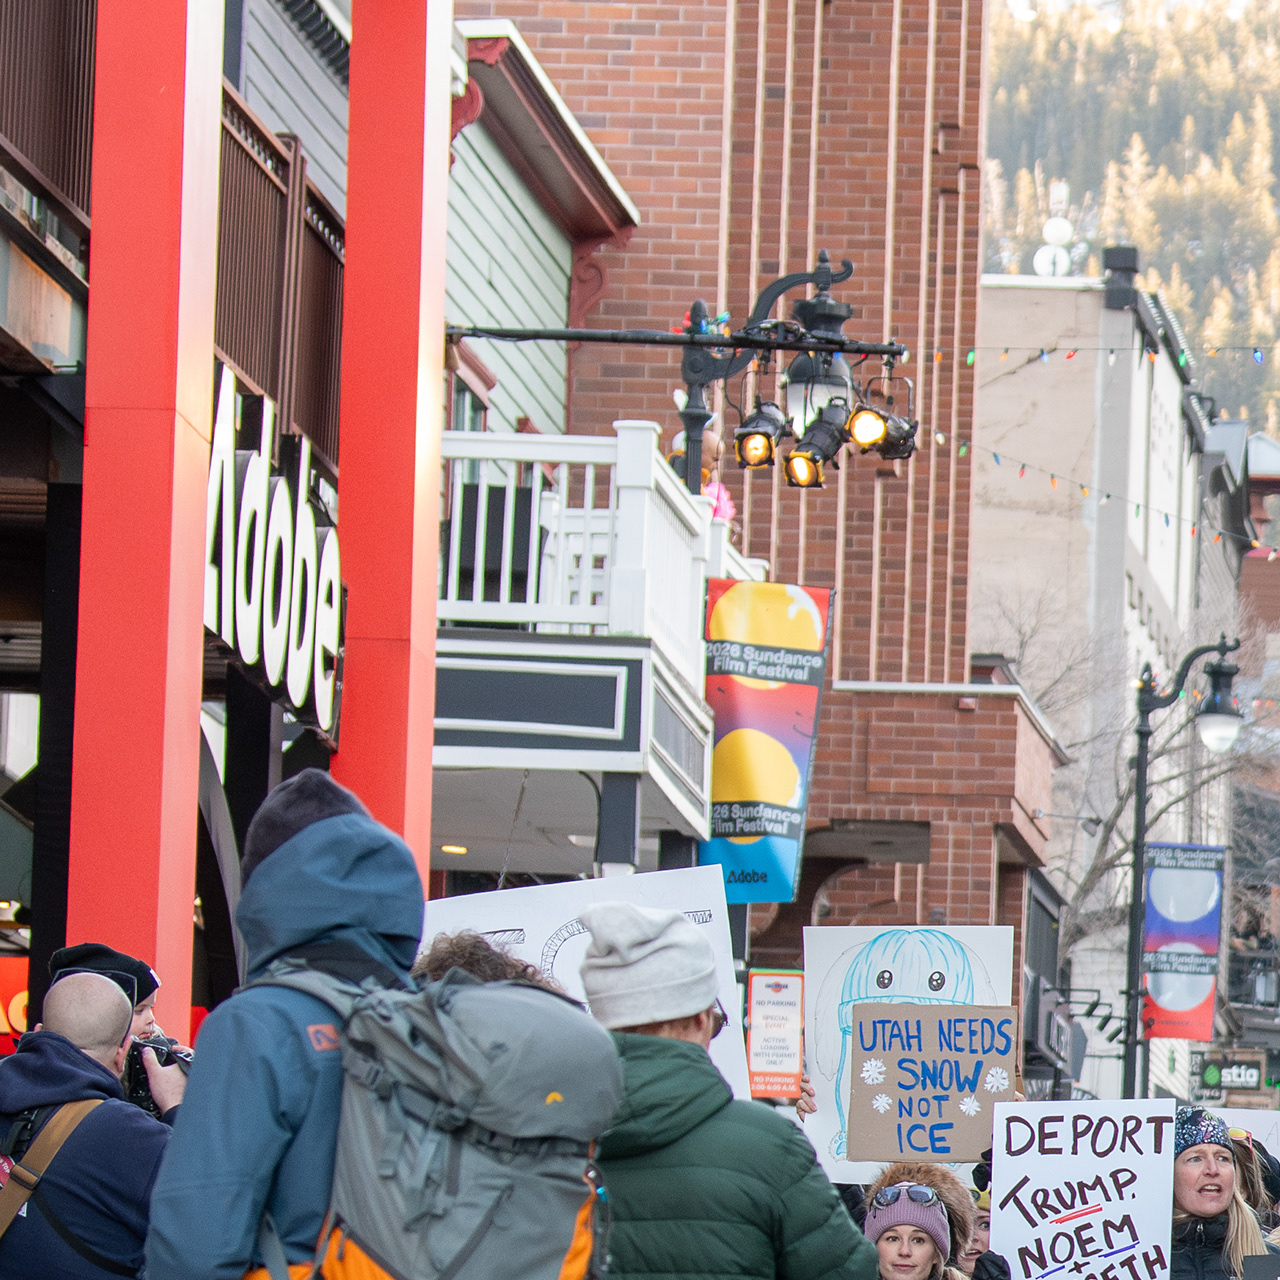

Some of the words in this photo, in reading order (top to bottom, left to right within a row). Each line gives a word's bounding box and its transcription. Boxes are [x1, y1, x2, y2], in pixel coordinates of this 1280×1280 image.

[203, 362, 341, 730] Adobe
[706, 642, 741, 658] 2026
[742, 645, 823, 668] Sundance
[713, 656, 746, 674] Film
[747, 660, 809, 681] Festival
[730, 803, 801, 824] Sundance
[736, 817, 788, 834] Festival
[726, 869, 768, 884] Adobe
[762, 1014, 789, 1022] SPECIAL
[764, 1021, 786, 1029] EVENT
[859, 1019, 923, 1052] UTAH
[938, 1018, 1012, 1056] NEEDS
[897, 1057, 984, 1093] SNOW
[1221, 1064, 1260, 1082] stio
[898, 1094, 950, 1118] NOT
[896, 1122, 954, 1154] ICE
[1005, 1113, 1174, 1158] DEPORT
[1017, 1213, 1140, 1279] NOEM
